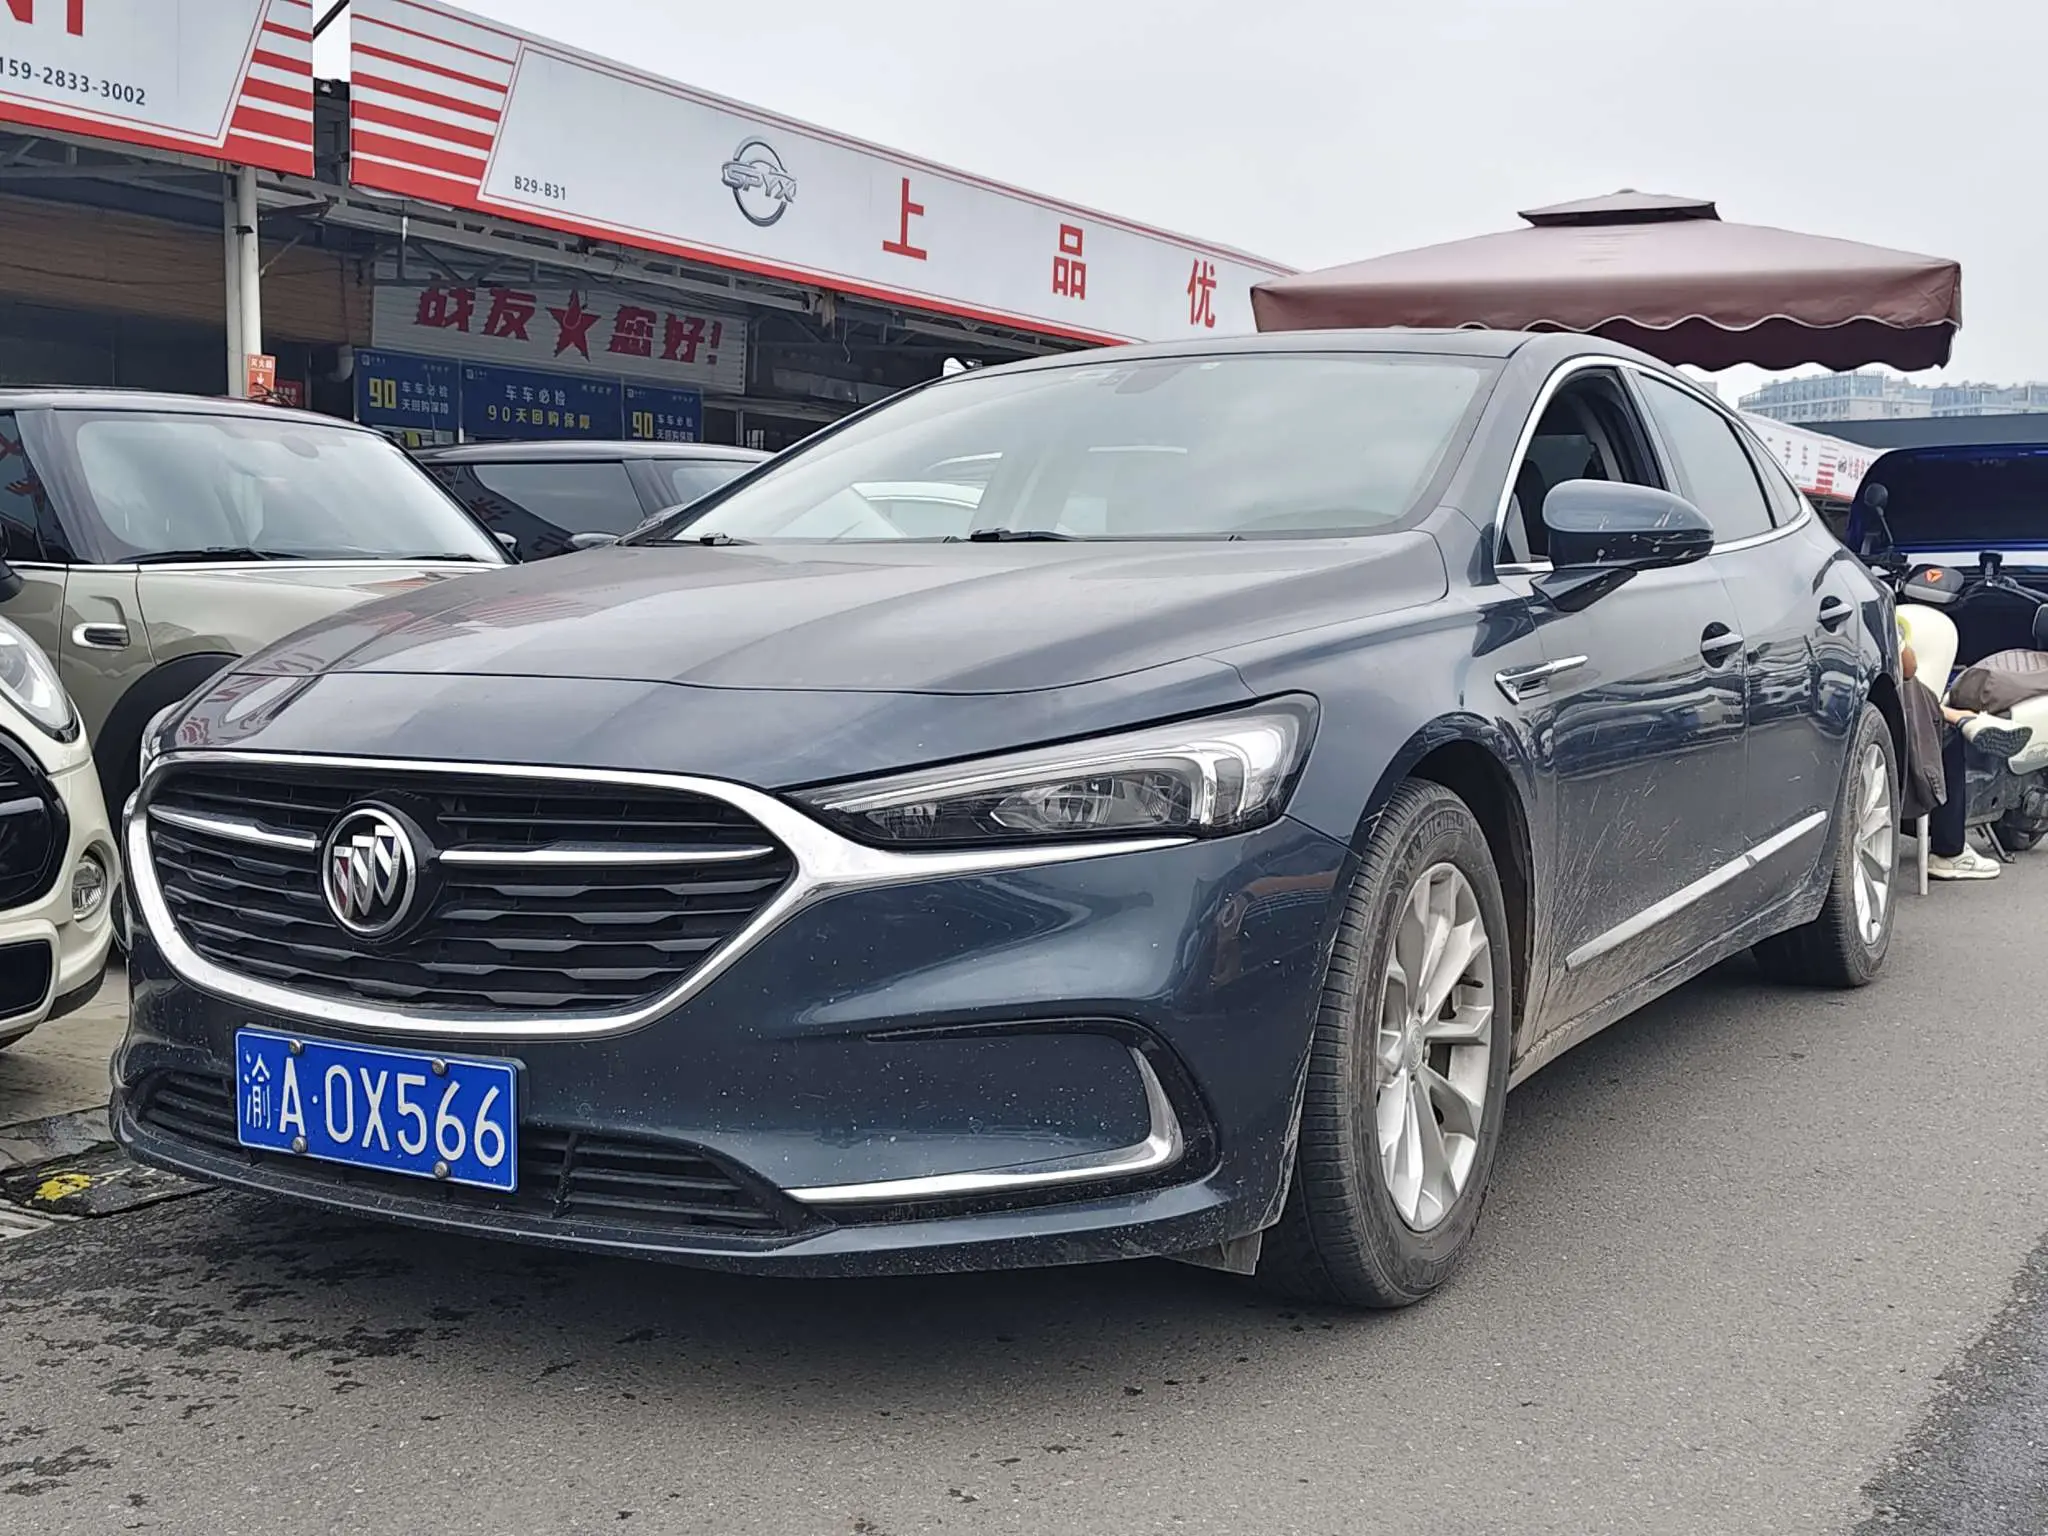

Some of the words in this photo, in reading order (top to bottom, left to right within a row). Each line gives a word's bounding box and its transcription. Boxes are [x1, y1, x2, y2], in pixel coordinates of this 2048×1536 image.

[0, 57, 146, 105] 159-2833-3002
[514, 176, 566, 200] B29-B31
[369, 377, 397, 409] 90
[506, 385, 566, 406] 车车必检
[632, 411, 654, 439] 90
